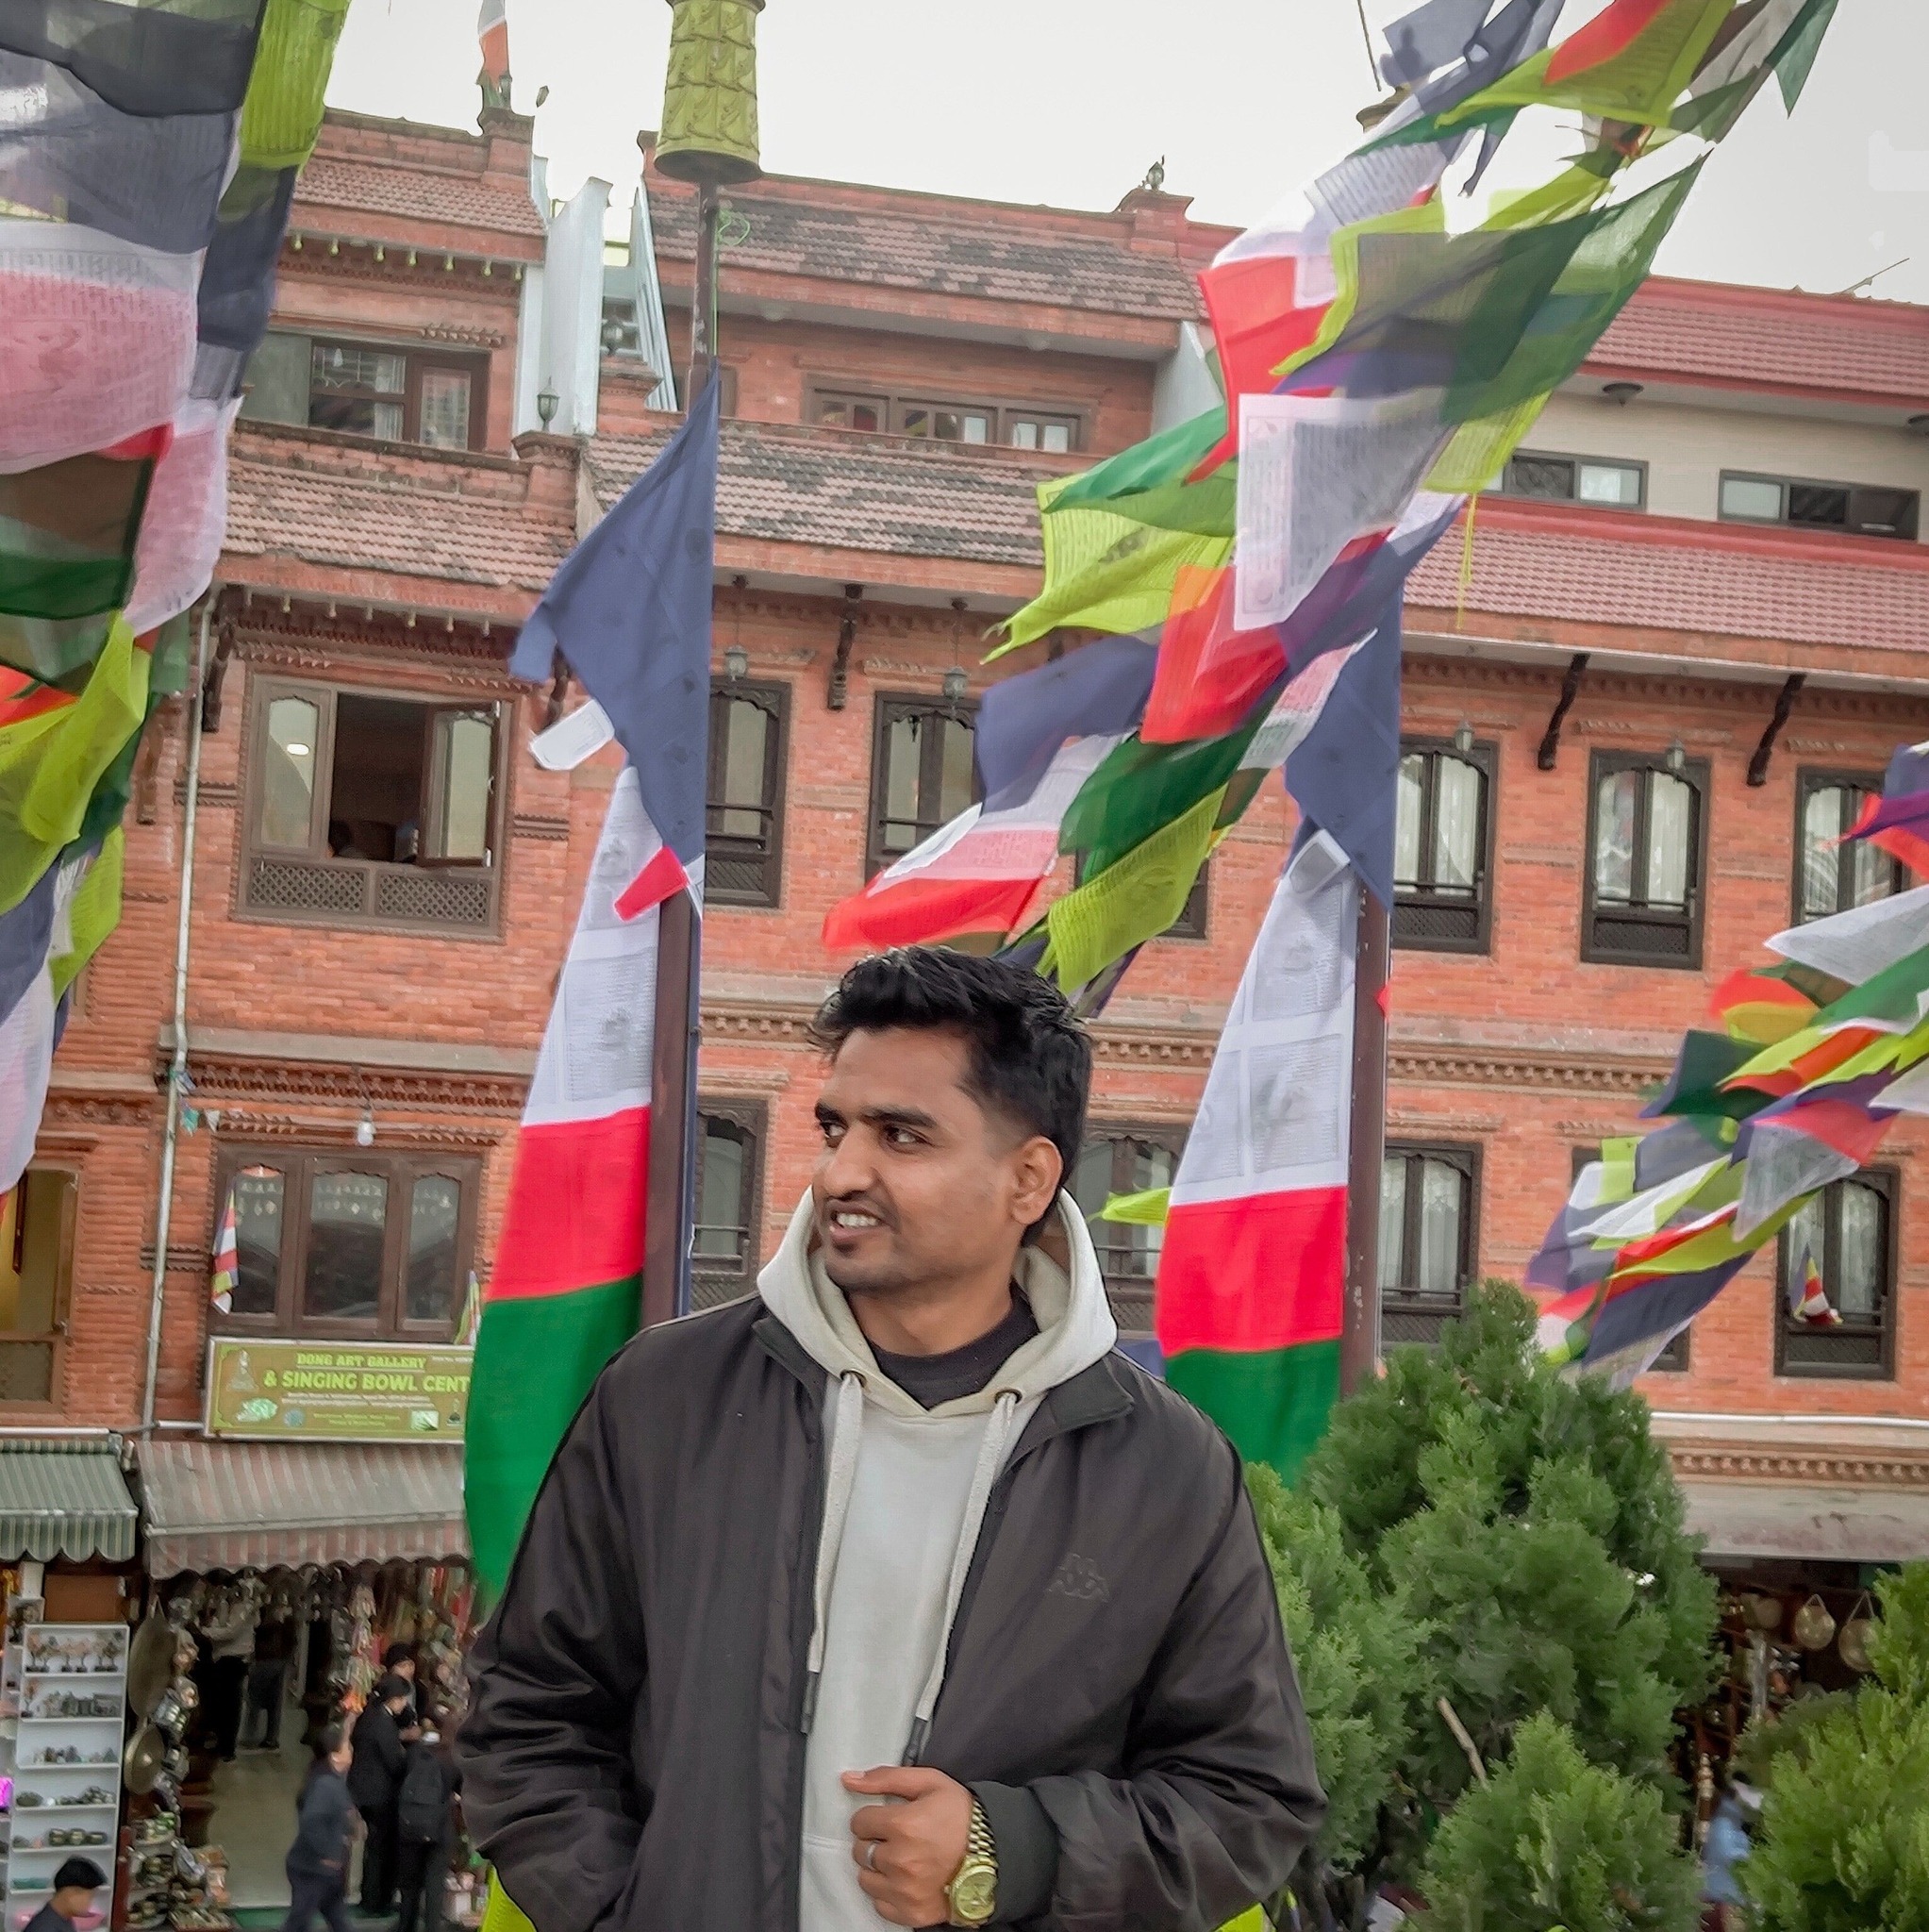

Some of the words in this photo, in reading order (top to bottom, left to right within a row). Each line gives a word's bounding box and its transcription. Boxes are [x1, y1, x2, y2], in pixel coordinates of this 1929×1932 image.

[336, 1354, 364, 1367] ART
[367, 1355, 426, 1369] GALLERY
[263, 1370, 277, 1387] &
[282, 1371, 358, 1389] SINGING
[361, 1374, 418, 1391] BOWL
